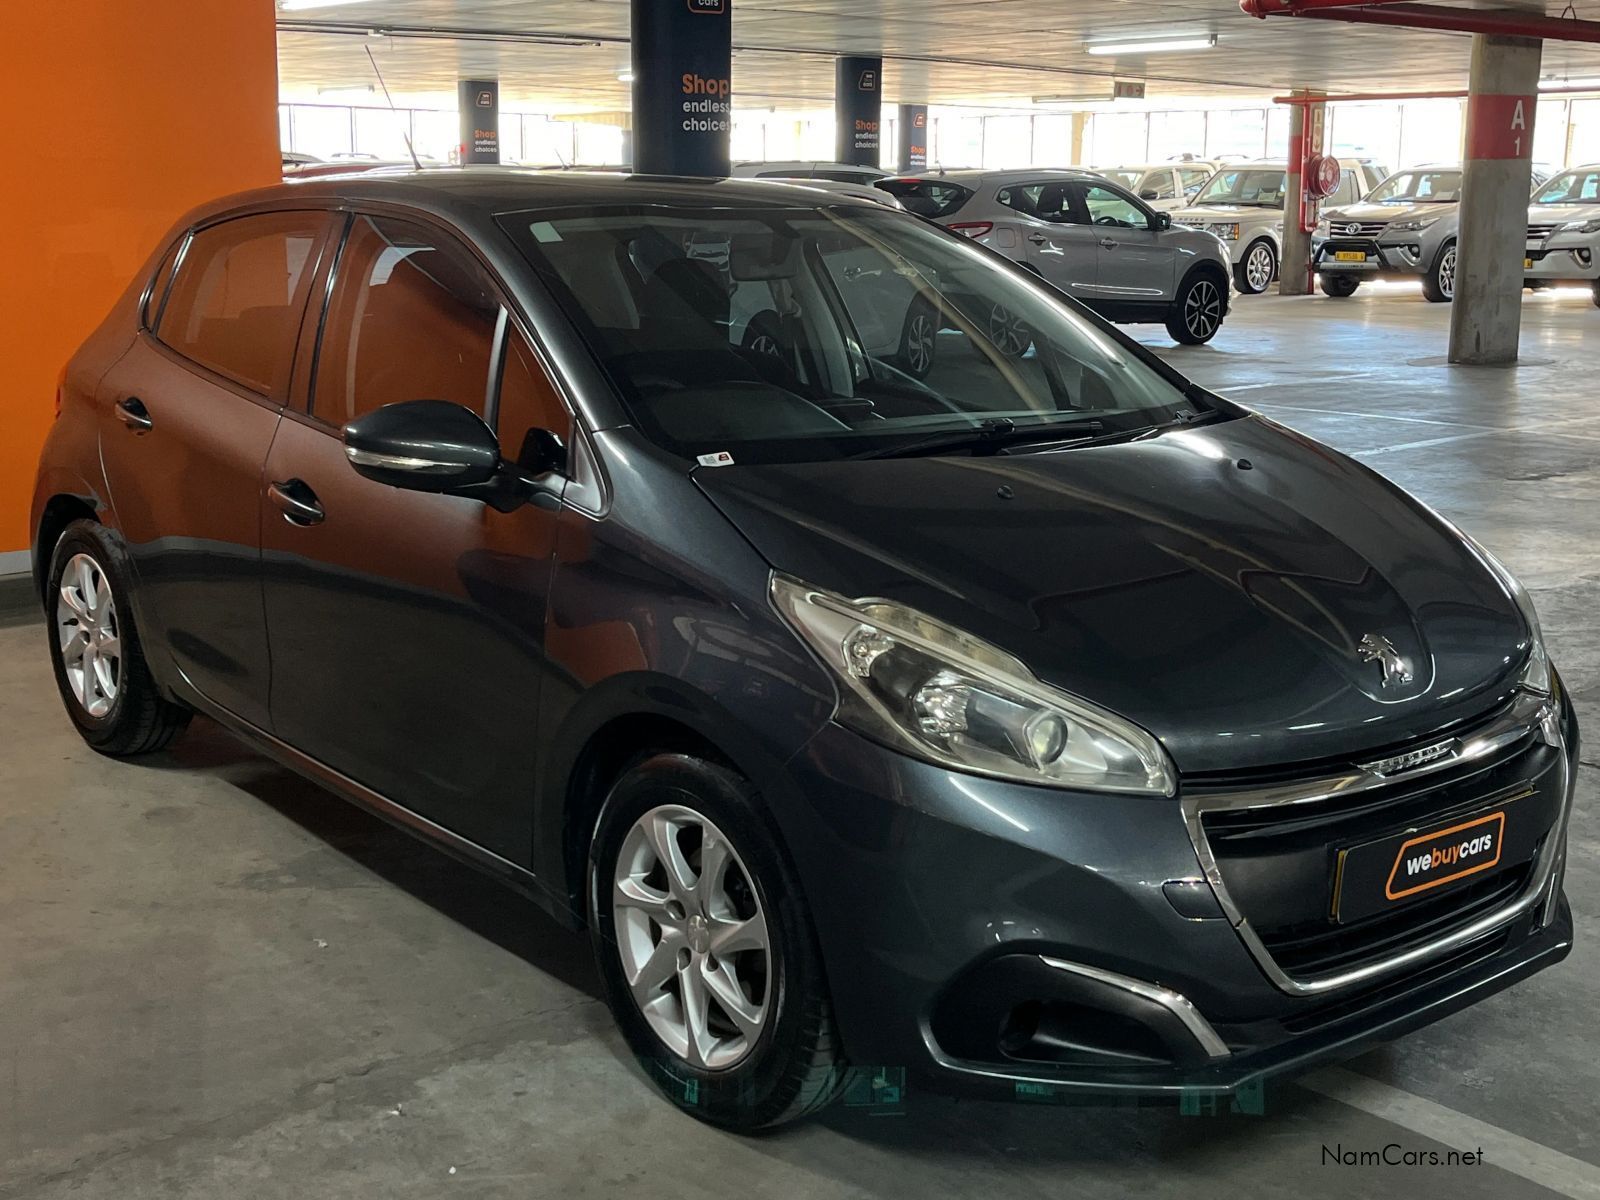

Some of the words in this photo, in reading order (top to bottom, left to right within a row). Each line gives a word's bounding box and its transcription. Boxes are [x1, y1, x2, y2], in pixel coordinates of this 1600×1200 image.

[682, 73, 730, 99] Shop
[682, 99, 730, 113] endless
[1511, 100, 1525, 130] A
[474, 130, 496, 140] Shop
[855, 120, 878, 132] Shop
[1514, 136, 1521, 156] 1
[1407, 834, 1492, 875] webuycars
